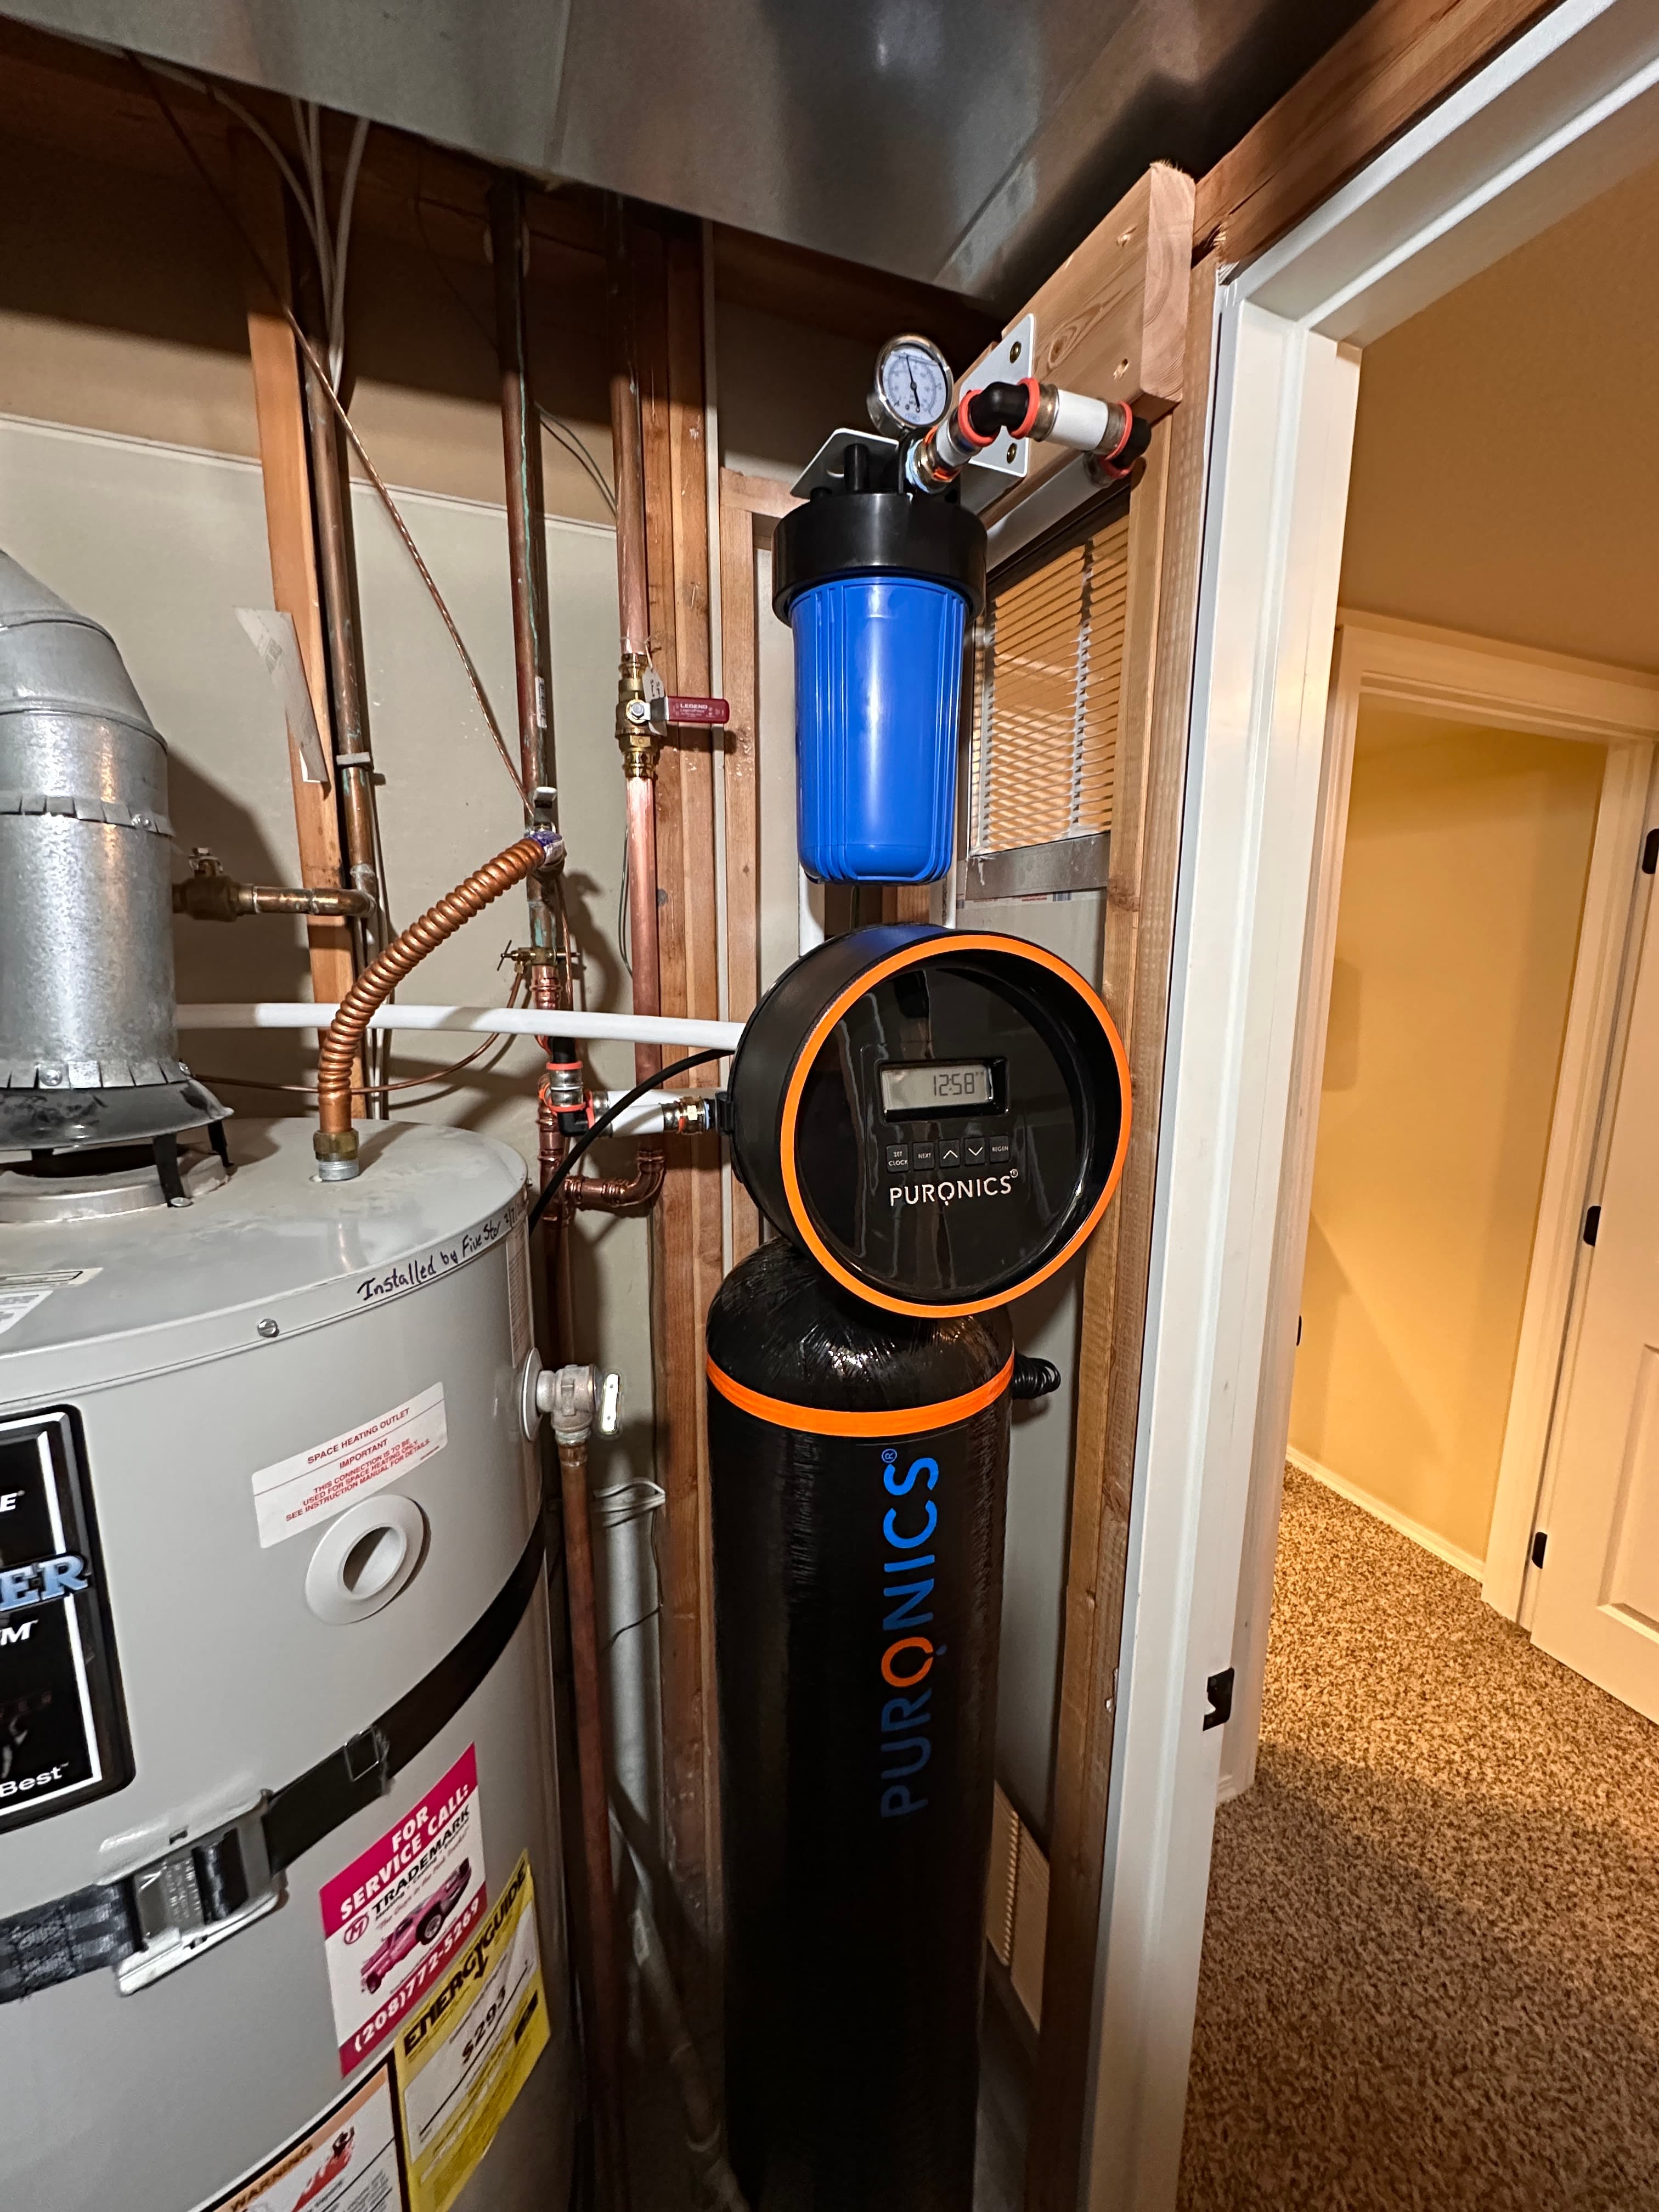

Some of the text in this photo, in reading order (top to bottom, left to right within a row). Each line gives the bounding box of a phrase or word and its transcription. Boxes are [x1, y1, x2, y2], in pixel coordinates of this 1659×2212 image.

[934, 1073, 975, 1097] 12:58
[357, 1255, 436, 1301] Installed
[440, 1251, 459, 1265] by
[307, 1408, 410, 1464] SPACE HEATING OUTLET
[313, 1438, 410, 1494] THIS CONNECTION IS TO BE
[340, 1438, 388, 1469] IMPORTANT
[286, 1509, 303, 1522] SEE
[305, 1482, 358, 1512] INSTRUCTION
[360, 1464, 389, 1485] MANUAL
[391, 1456, 404, 1469] FOR
[302, 1491, 326, 1506] USED
[328, 1482, 344, 1496] FOR
[345, 1468, 370, 1485] SPACE
[371, 1450, 401, 1471] HEATING
[402, 1440, 418, 1455] ONLY
[340, 1835, 422, 1921] SERVICE
[427, 1784, 469, 1836] CALL:
[371, 1803, 470, 1914] TRADEMARK
[392, 1806, 429, 1853] FOR
[354, 1897, 481, 2052] (208)772-5269
[230, 2143, 313, 2211] WARNING
